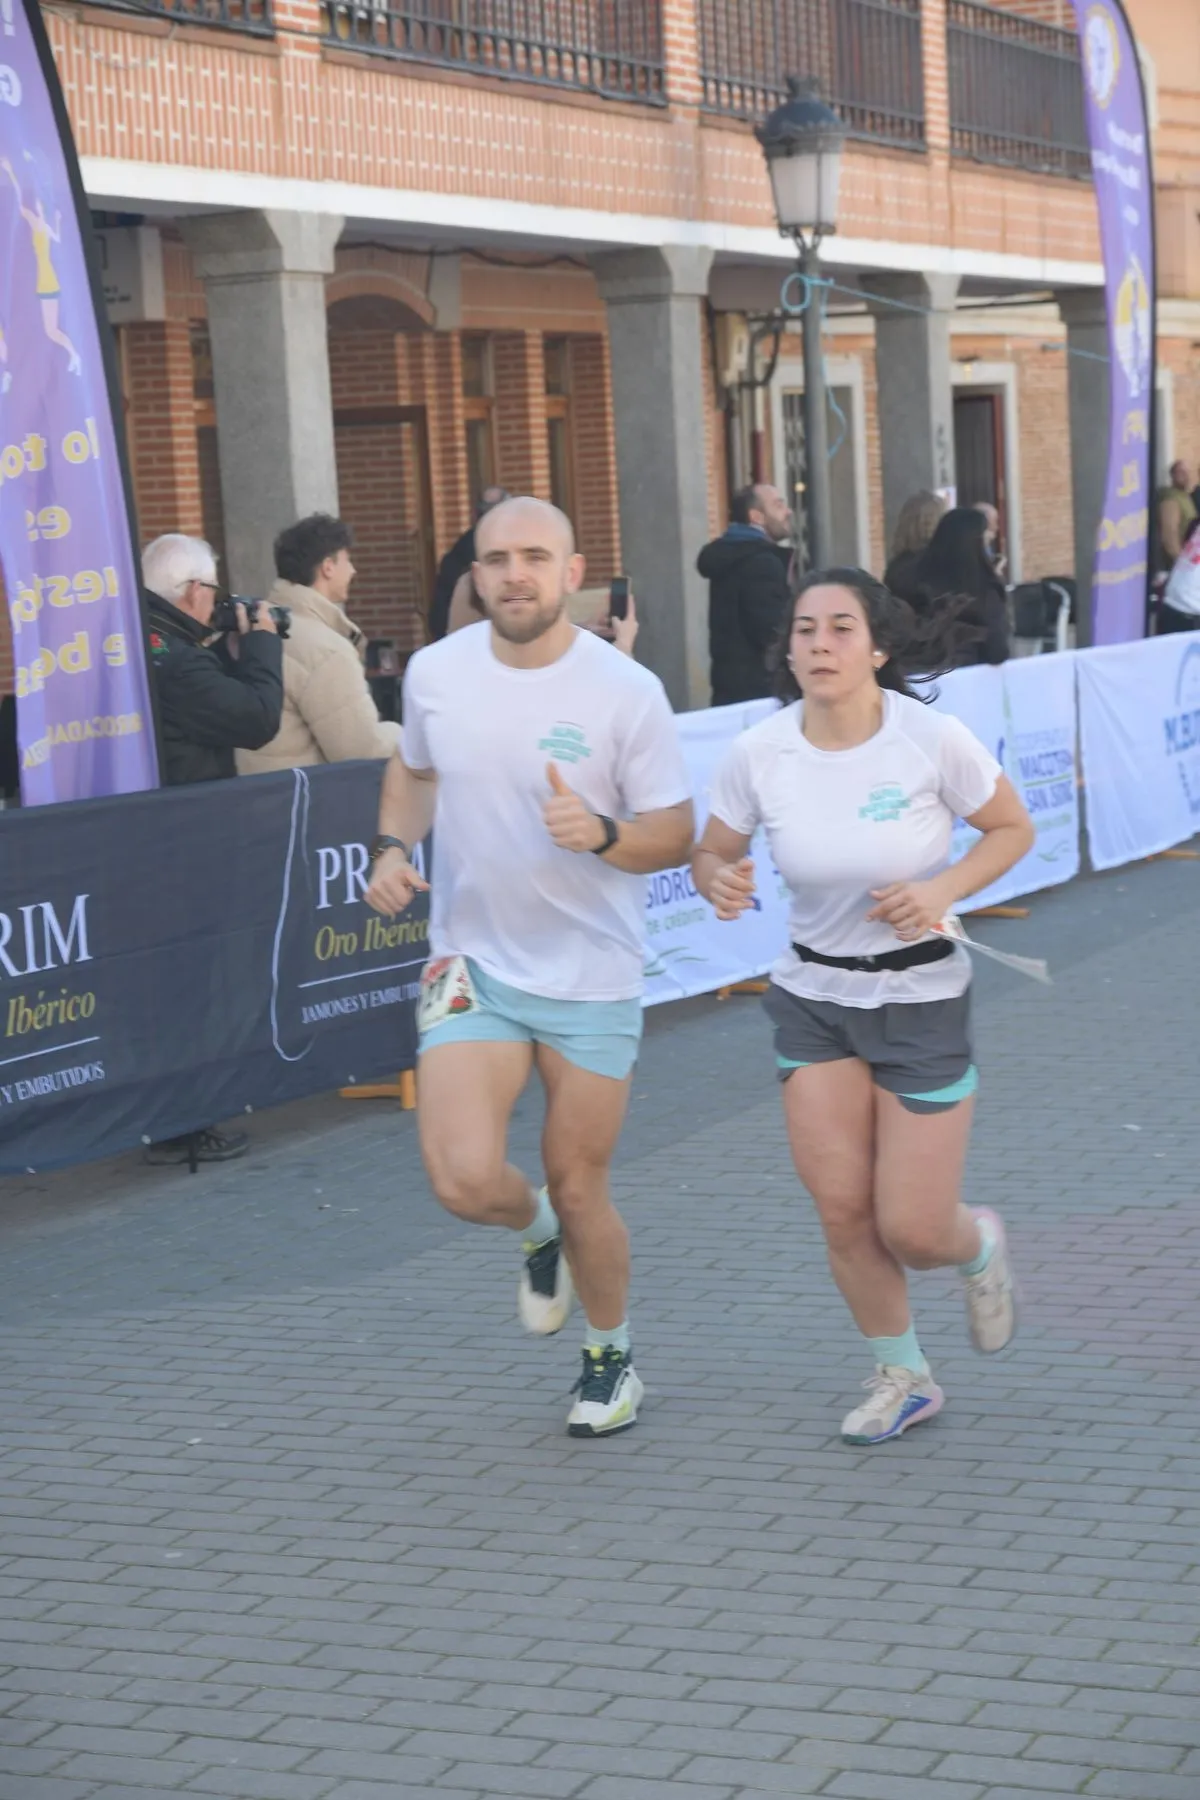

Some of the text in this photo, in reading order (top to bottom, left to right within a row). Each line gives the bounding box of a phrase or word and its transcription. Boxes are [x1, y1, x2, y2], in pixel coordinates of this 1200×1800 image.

[315, 925, 358, 961] Oro
[5, 988, 96, 1038] Ibérico
[301, 995, 360, 1024] JAMONES
[358, 992, 369, 1010] Y
[14, 1060, 105, 1101] EMBUTIDOS
